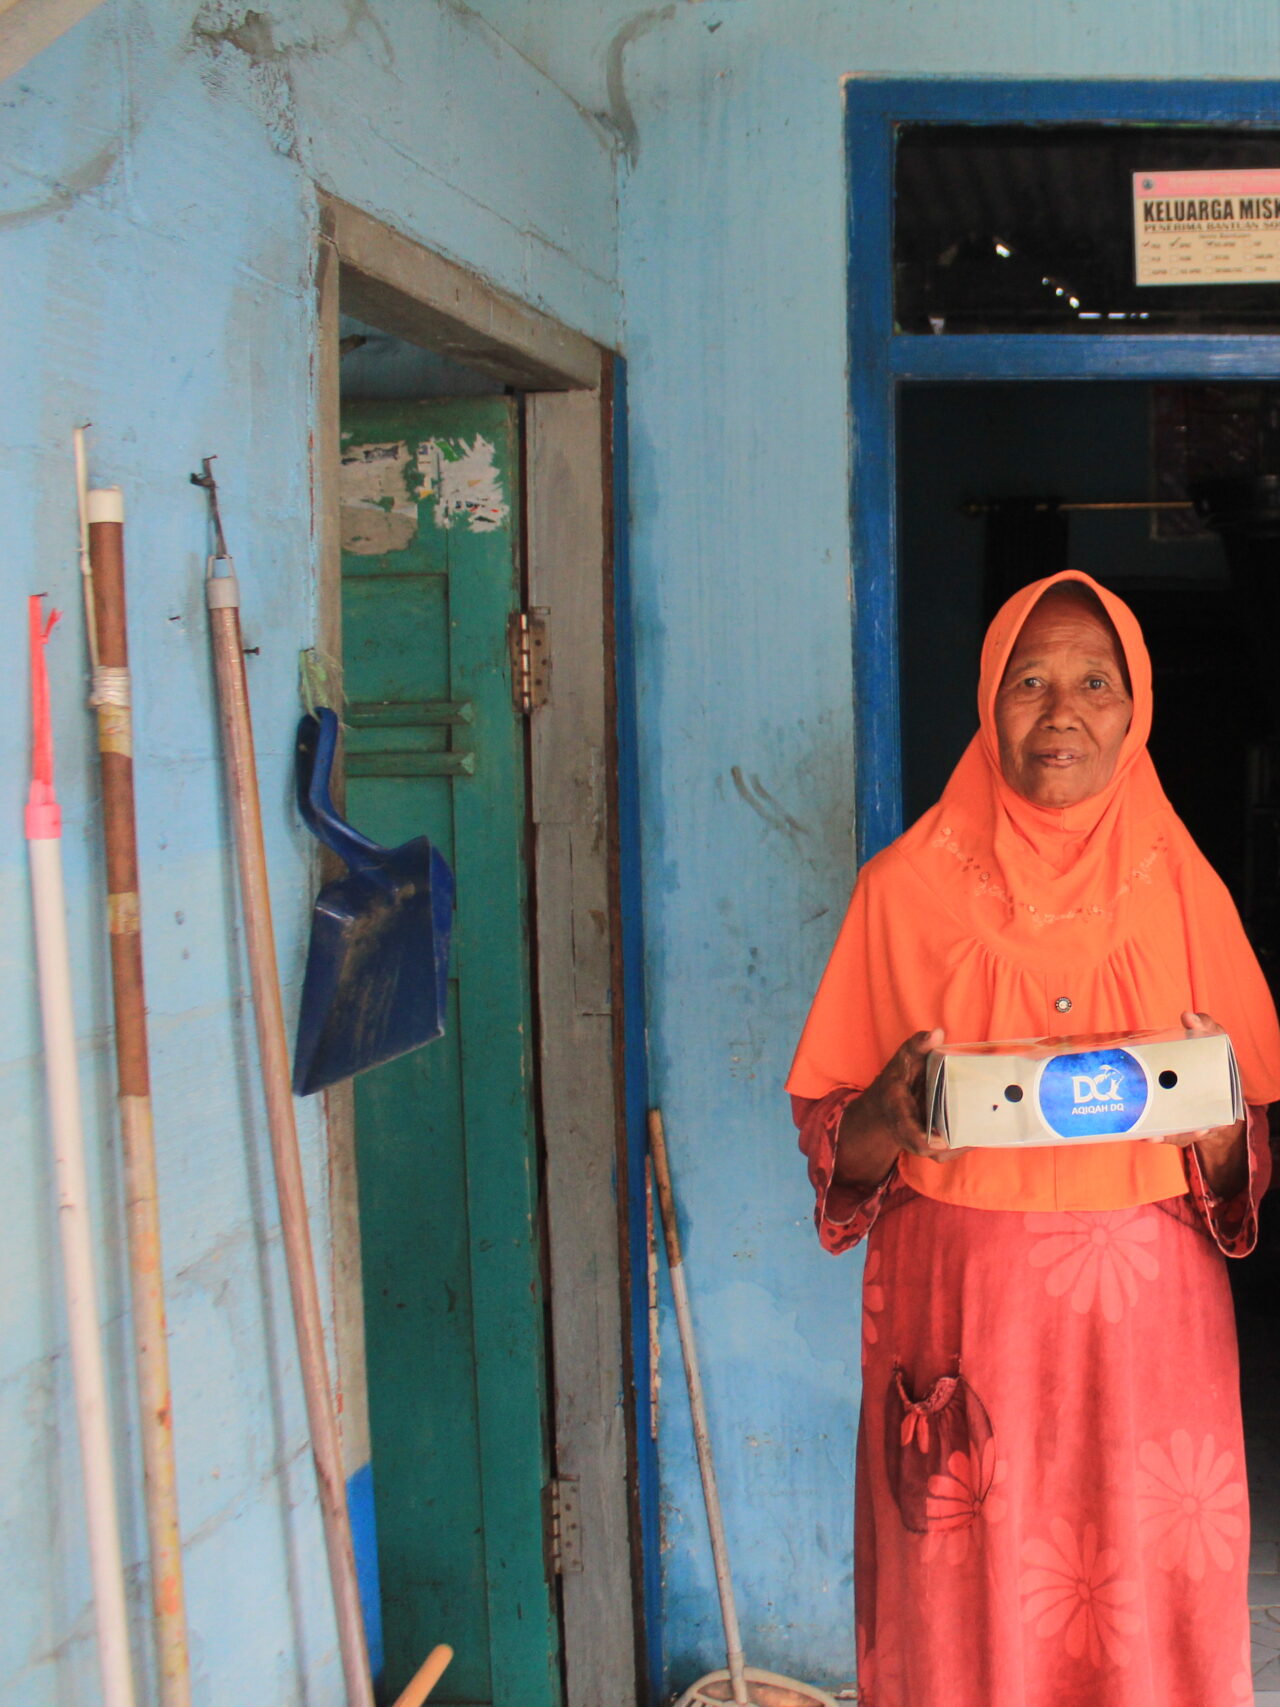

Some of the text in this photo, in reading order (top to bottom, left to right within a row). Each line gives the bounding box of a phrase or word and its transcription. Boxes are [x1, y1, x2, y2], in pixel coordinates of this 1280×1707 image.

[1143, 198, 1235, 222] KELUARGA
[1072, 1065, 1125, 1104] DQ
[1071, 1103, 1125, 1115] AQIQAH DQ
